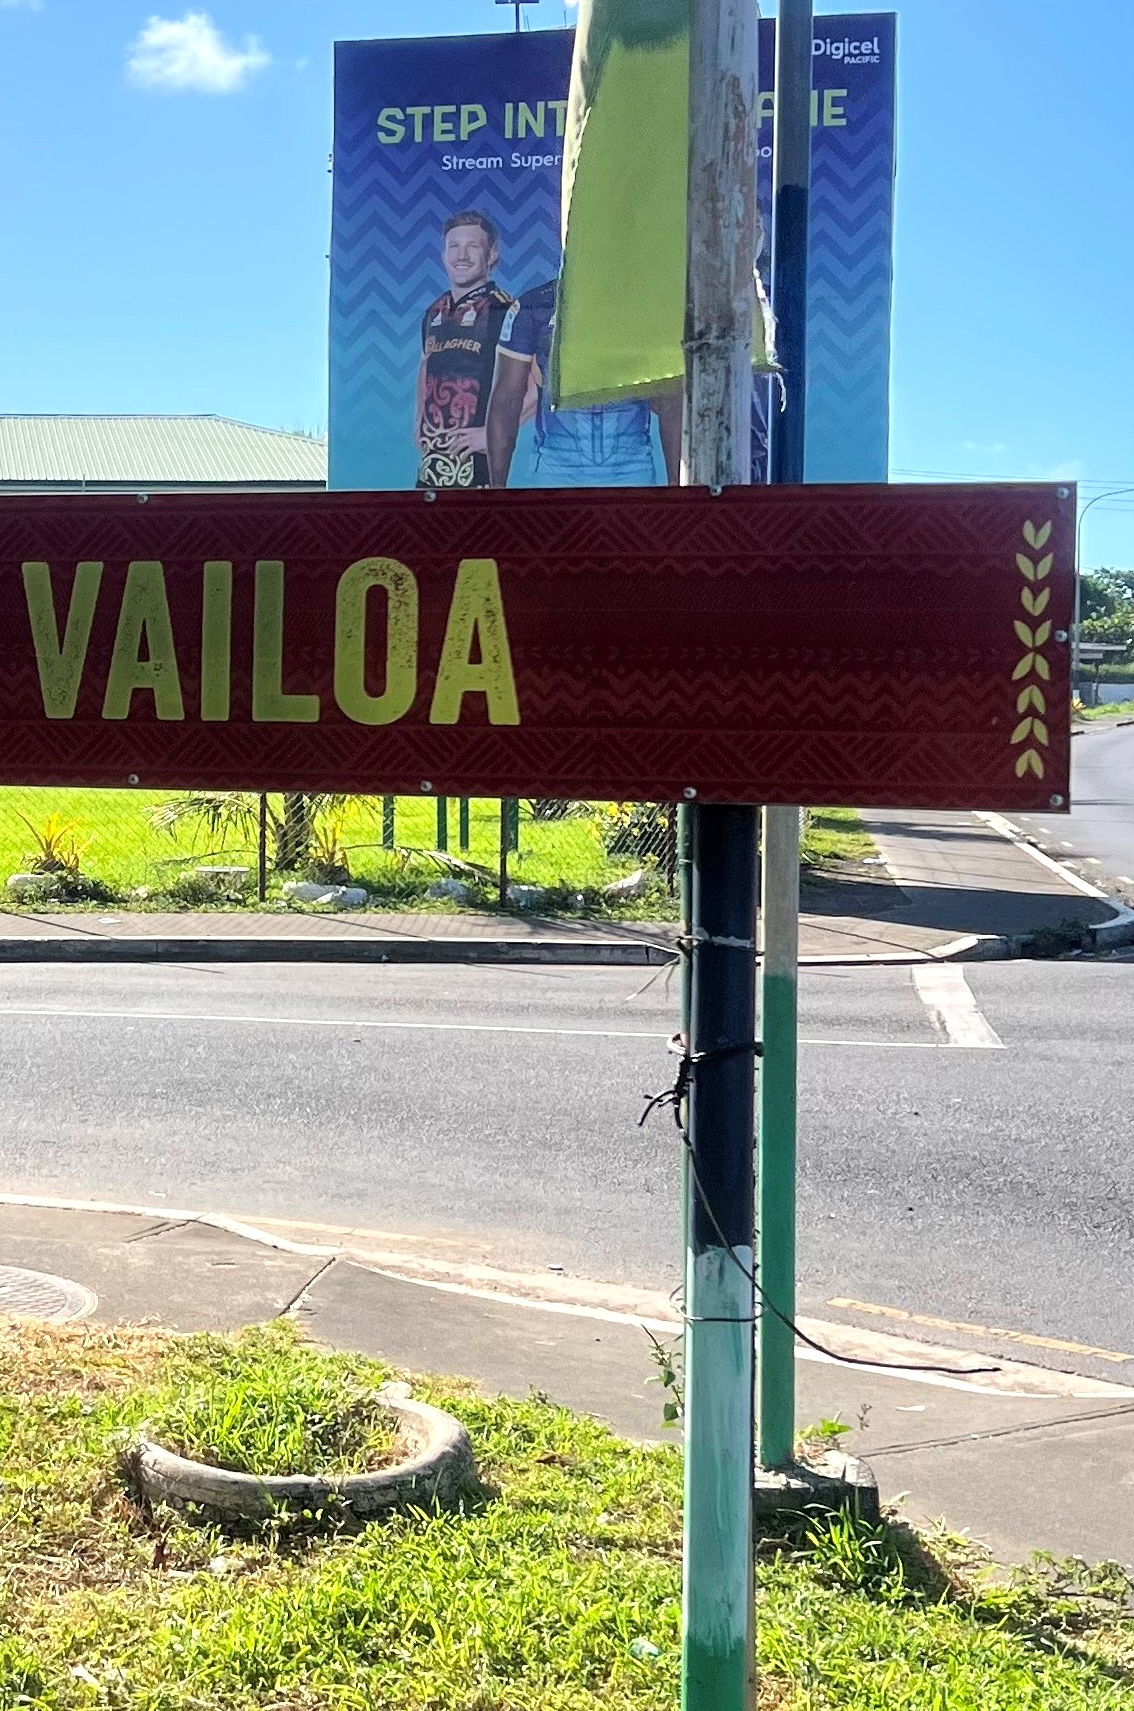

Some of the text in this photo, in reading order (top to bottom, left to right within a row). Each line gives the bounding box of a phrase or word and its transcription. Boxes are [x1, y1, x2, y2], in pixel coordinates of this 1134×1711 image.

[811, 37, 880, 59] Digicel
[844, 55, 880, 64] PACIFIC
[377, 104, 487, 144] STEP
[504, 100, 568, 138] INT
[441, 152, 563, 171] Stream Super
[21, 557, 521, 726] VAILOA
